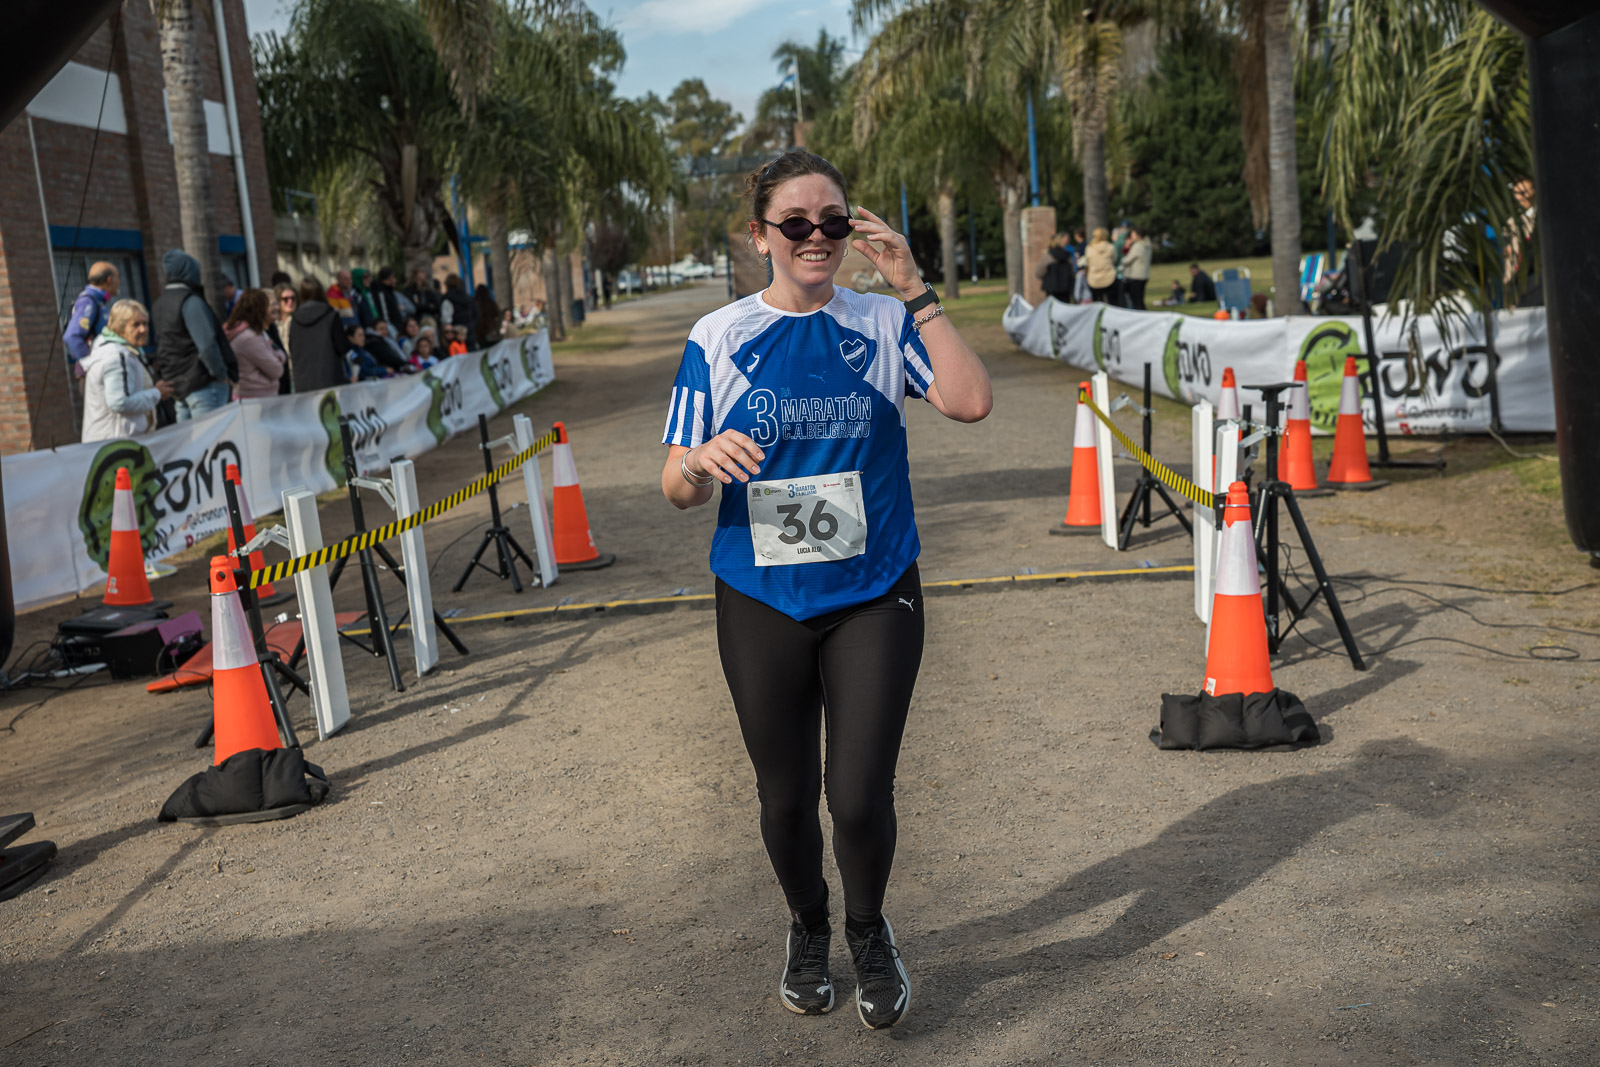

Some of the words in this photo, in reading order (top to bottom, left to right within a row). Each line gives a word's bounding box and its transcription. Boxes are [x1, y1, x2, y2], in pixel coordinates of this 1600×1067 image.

[747, 388, 779, 448] 3
[780, 391, 872, 422] MARATÓN
[776, 500, 838, 544] 36
